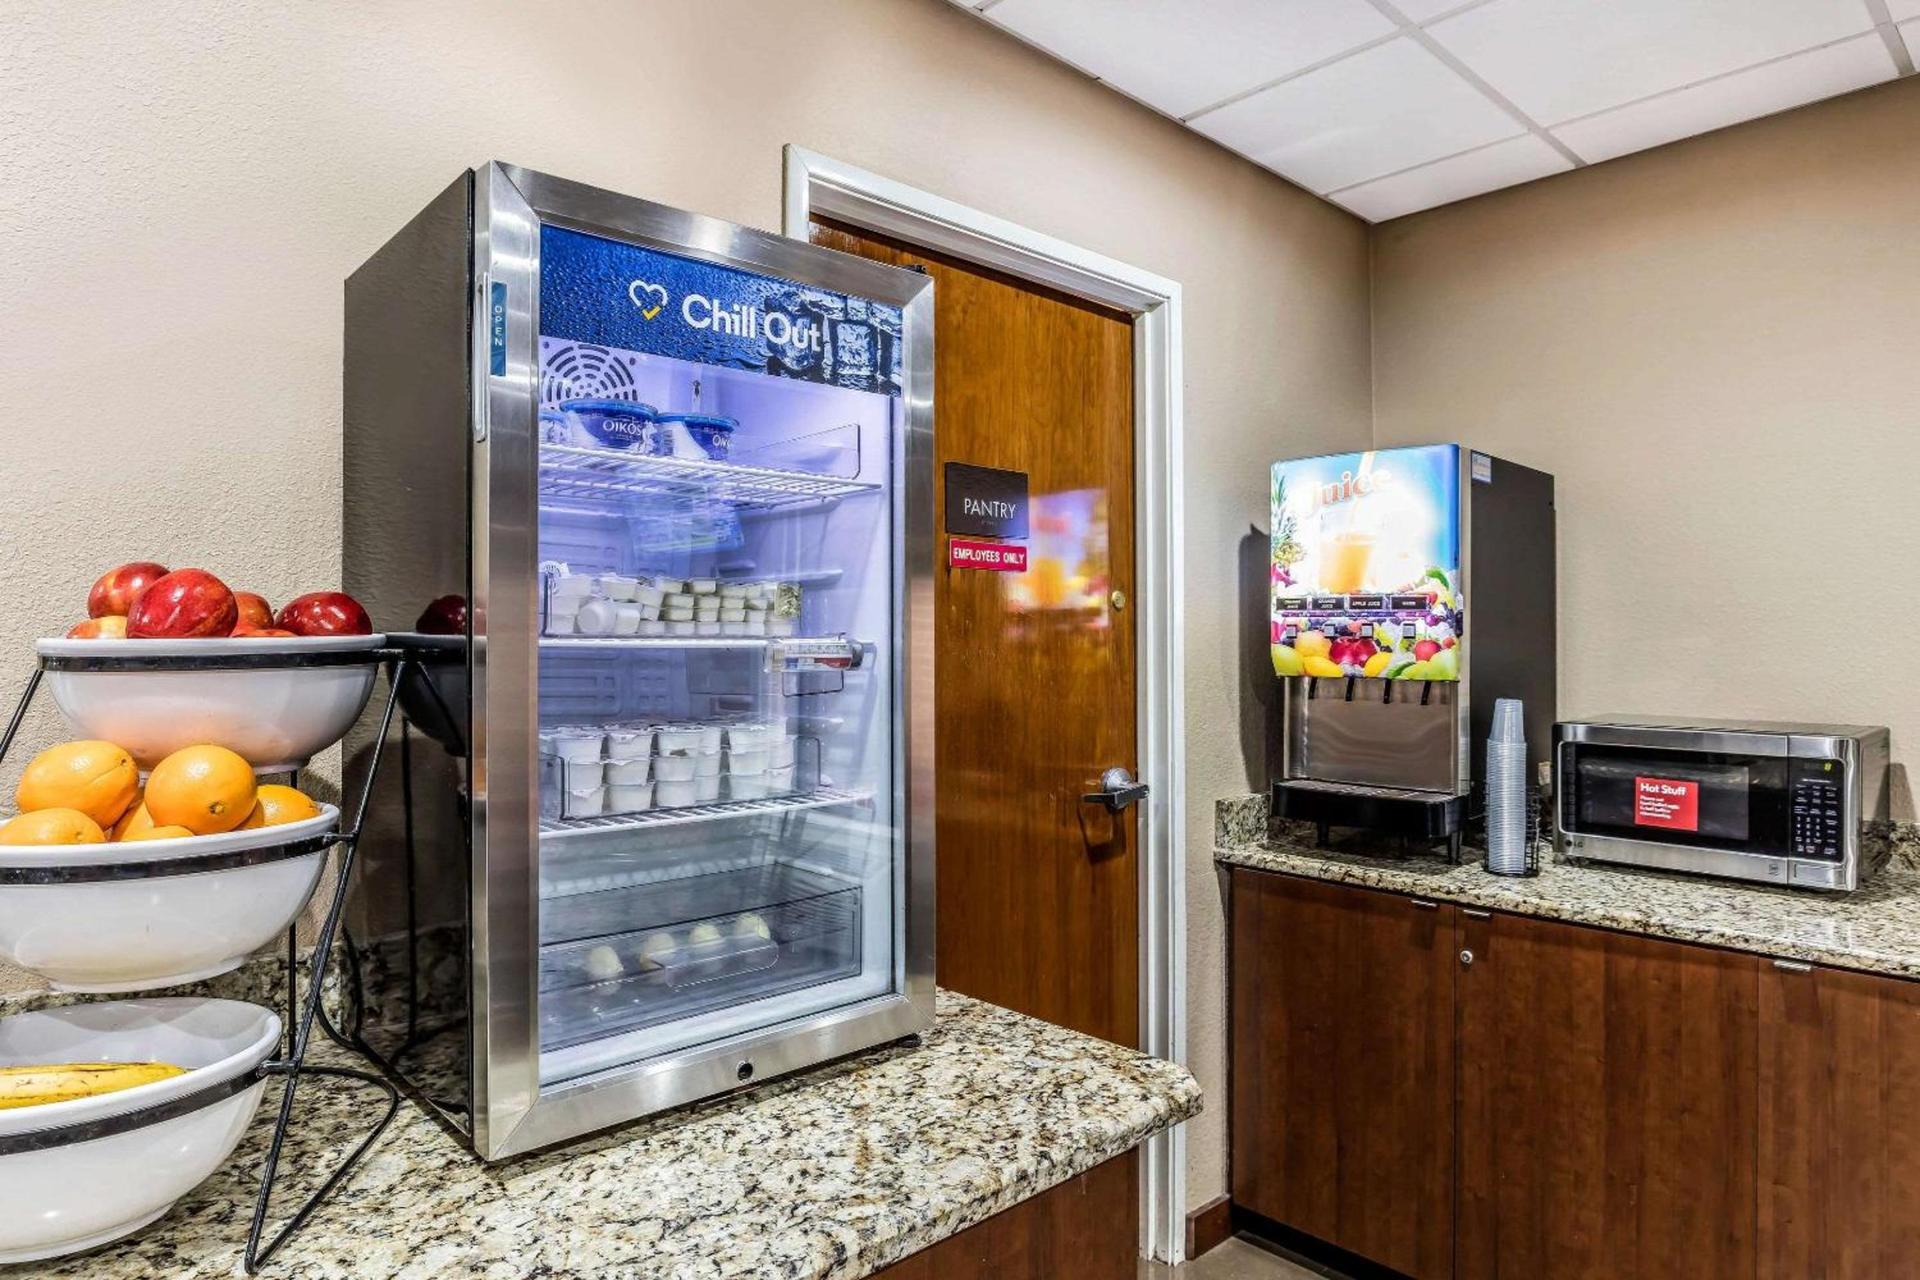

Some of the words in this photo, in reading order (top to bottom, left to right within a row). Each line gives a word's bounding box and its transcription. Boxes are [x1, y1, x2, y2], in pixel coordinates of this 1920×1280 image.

[682, 294, 755, 339] Chill
[764, 312, 821, 351] Out
[602, 420, 641, 436] OIKOS
[964, 498, 1016, 519] PANTRY
[953, 547, 1000, 562] EMPLOYEES
[1003, 552, 1025, 564] ONLY
[1640, 782, 1660, 793] Hot
[1661, 784, 1687, 796] Stuff
